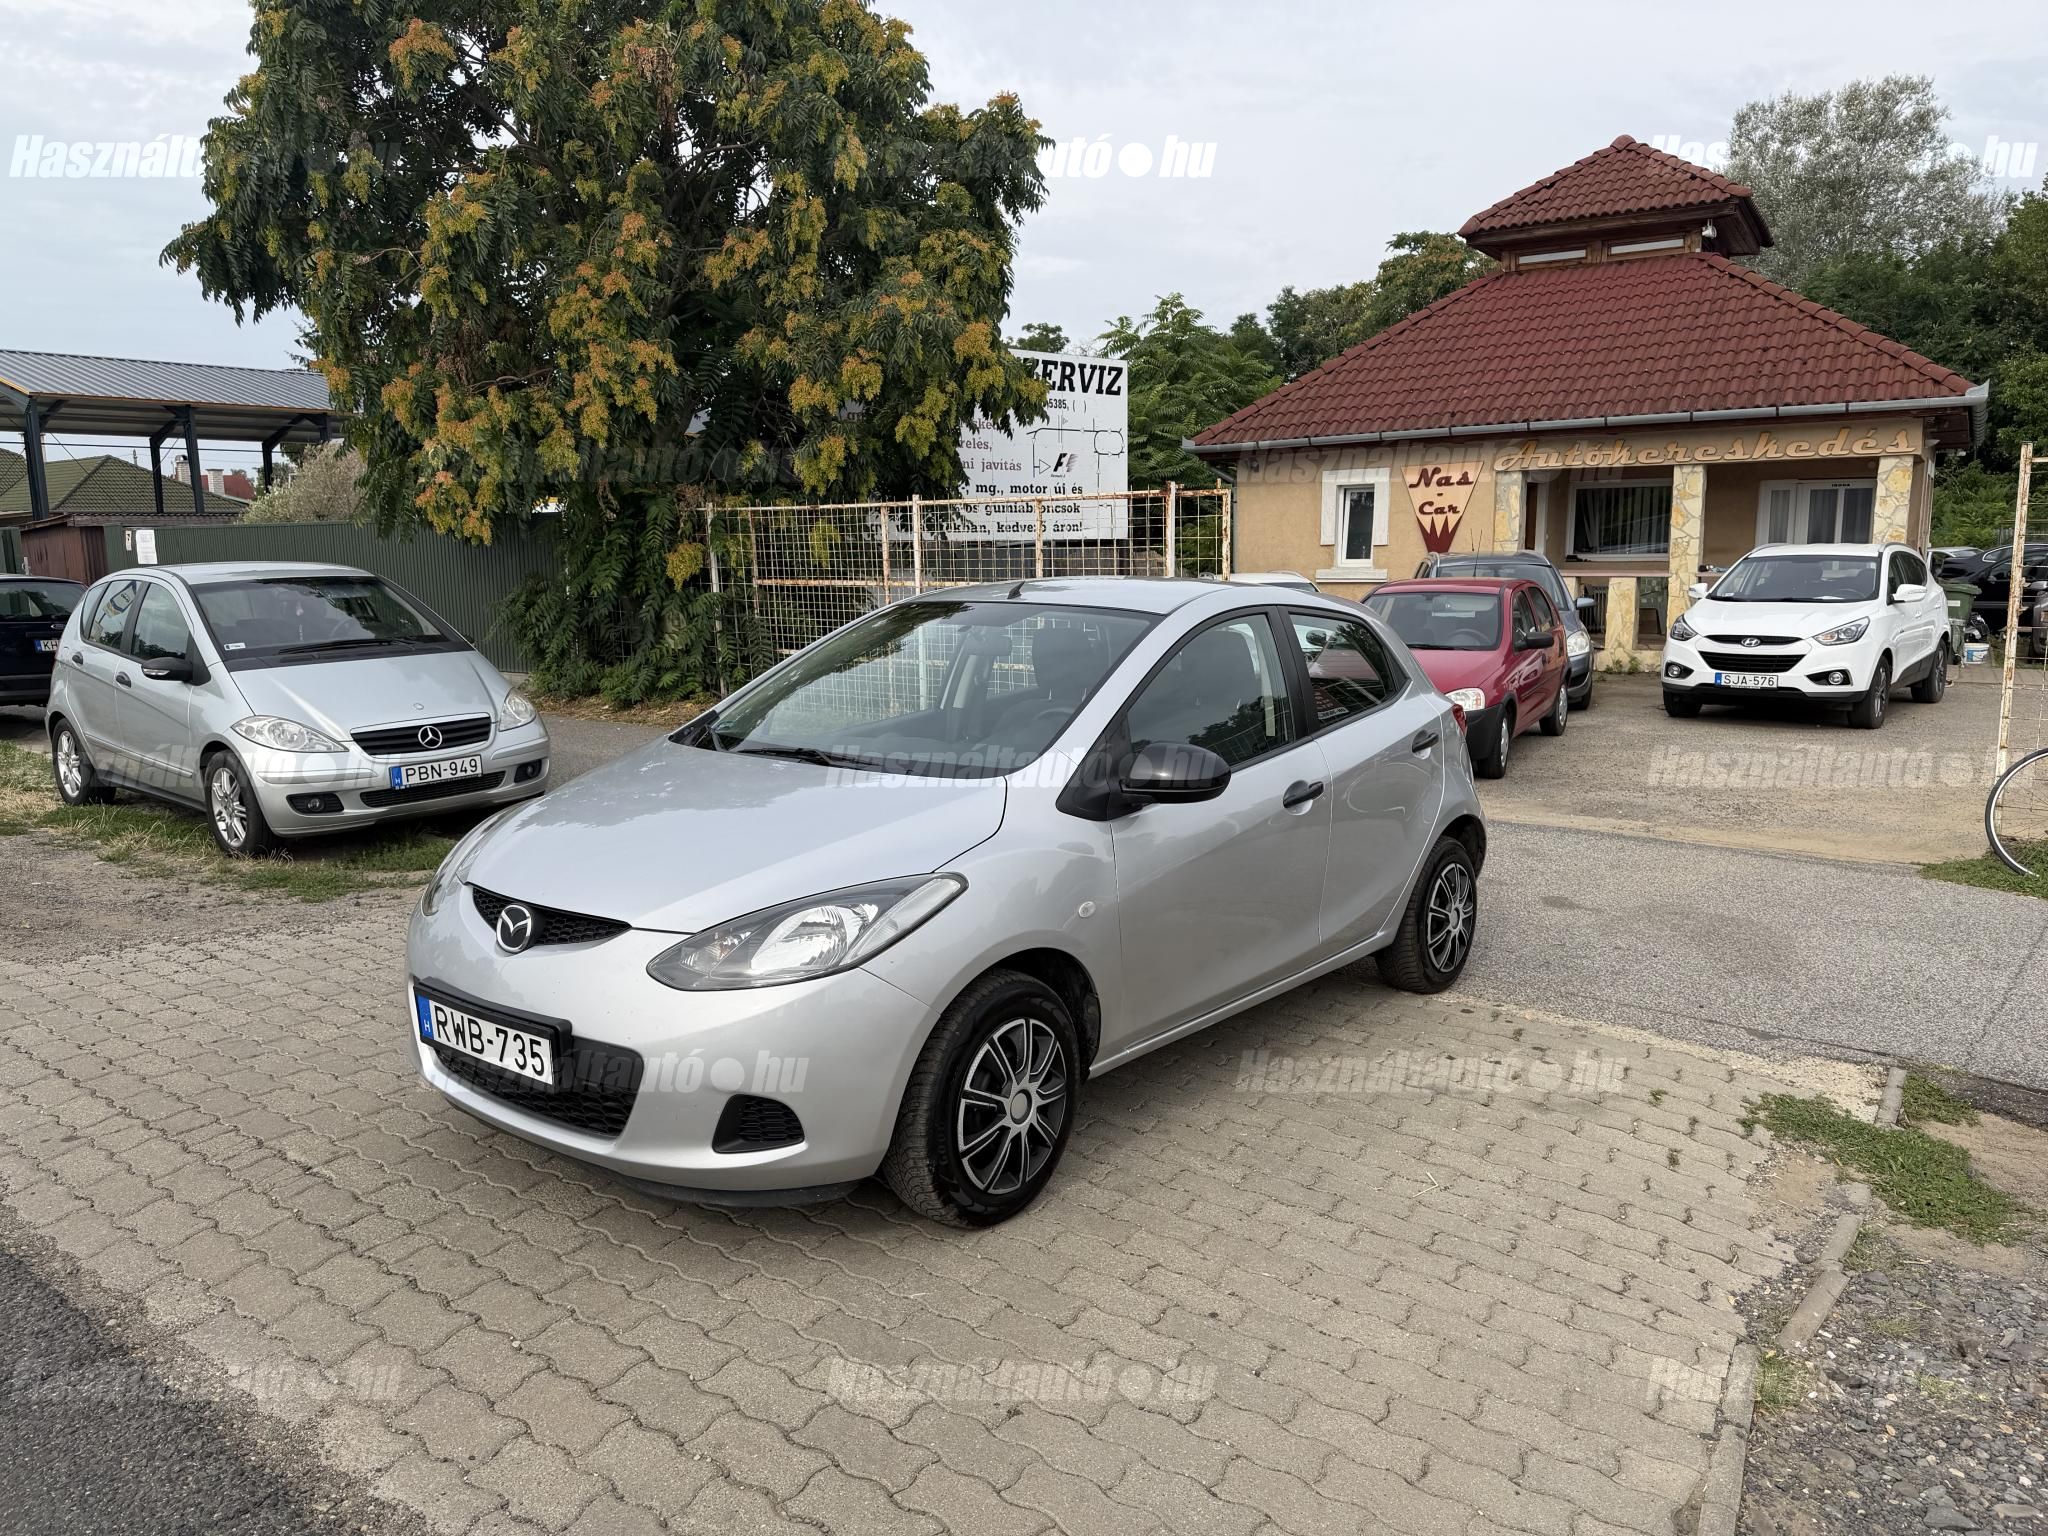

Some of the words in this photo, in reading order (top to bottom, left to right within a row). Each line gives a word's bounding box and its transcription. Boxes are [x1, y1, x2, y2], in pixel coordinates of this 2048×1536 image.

[1047, 398, 1070, 411] 5385,
[958, 437, 992, 452] relés,
[1494, 427, 1916, 471] Autókereskedés
[981, 459, 1022, 472] javítás
[1409, 467, 1474, 488] Nas
[1010, 484, 1048, 494] motor
[1054, 483, 1066, 495] új
[1072, 483, 1083, 494] és
[1418, 501, 1460, 515] Car
[1053, 520, 1083, 532] áron!
[1724, 675, 1775, 686] SJA-576
[405, 758, 478, 782] PBN-949
[435, 1004, 546, 1077] RWB-735
